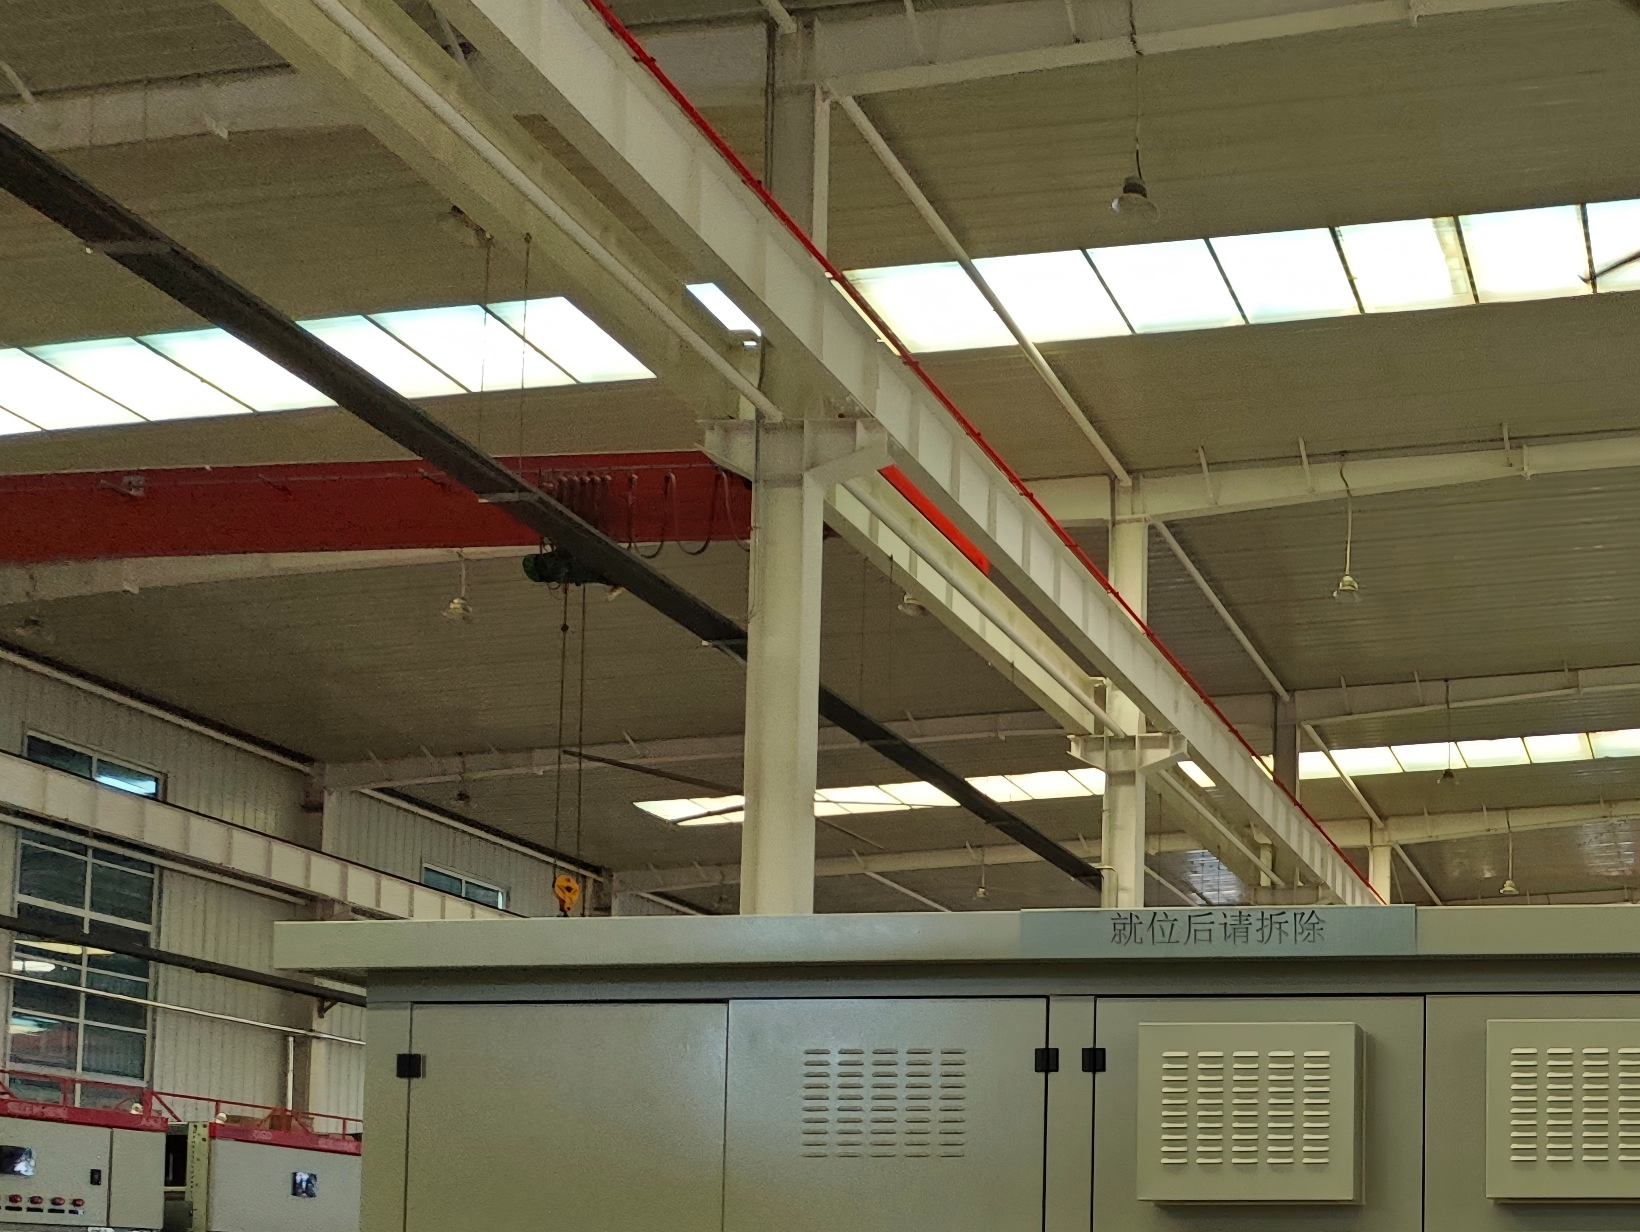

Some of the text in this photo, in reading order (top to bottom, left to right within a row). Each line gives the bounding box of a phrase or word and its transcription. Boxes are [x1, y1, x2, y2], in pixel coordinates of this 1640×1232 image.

[1110, 909, 1327, 946] 就位后请拆除
